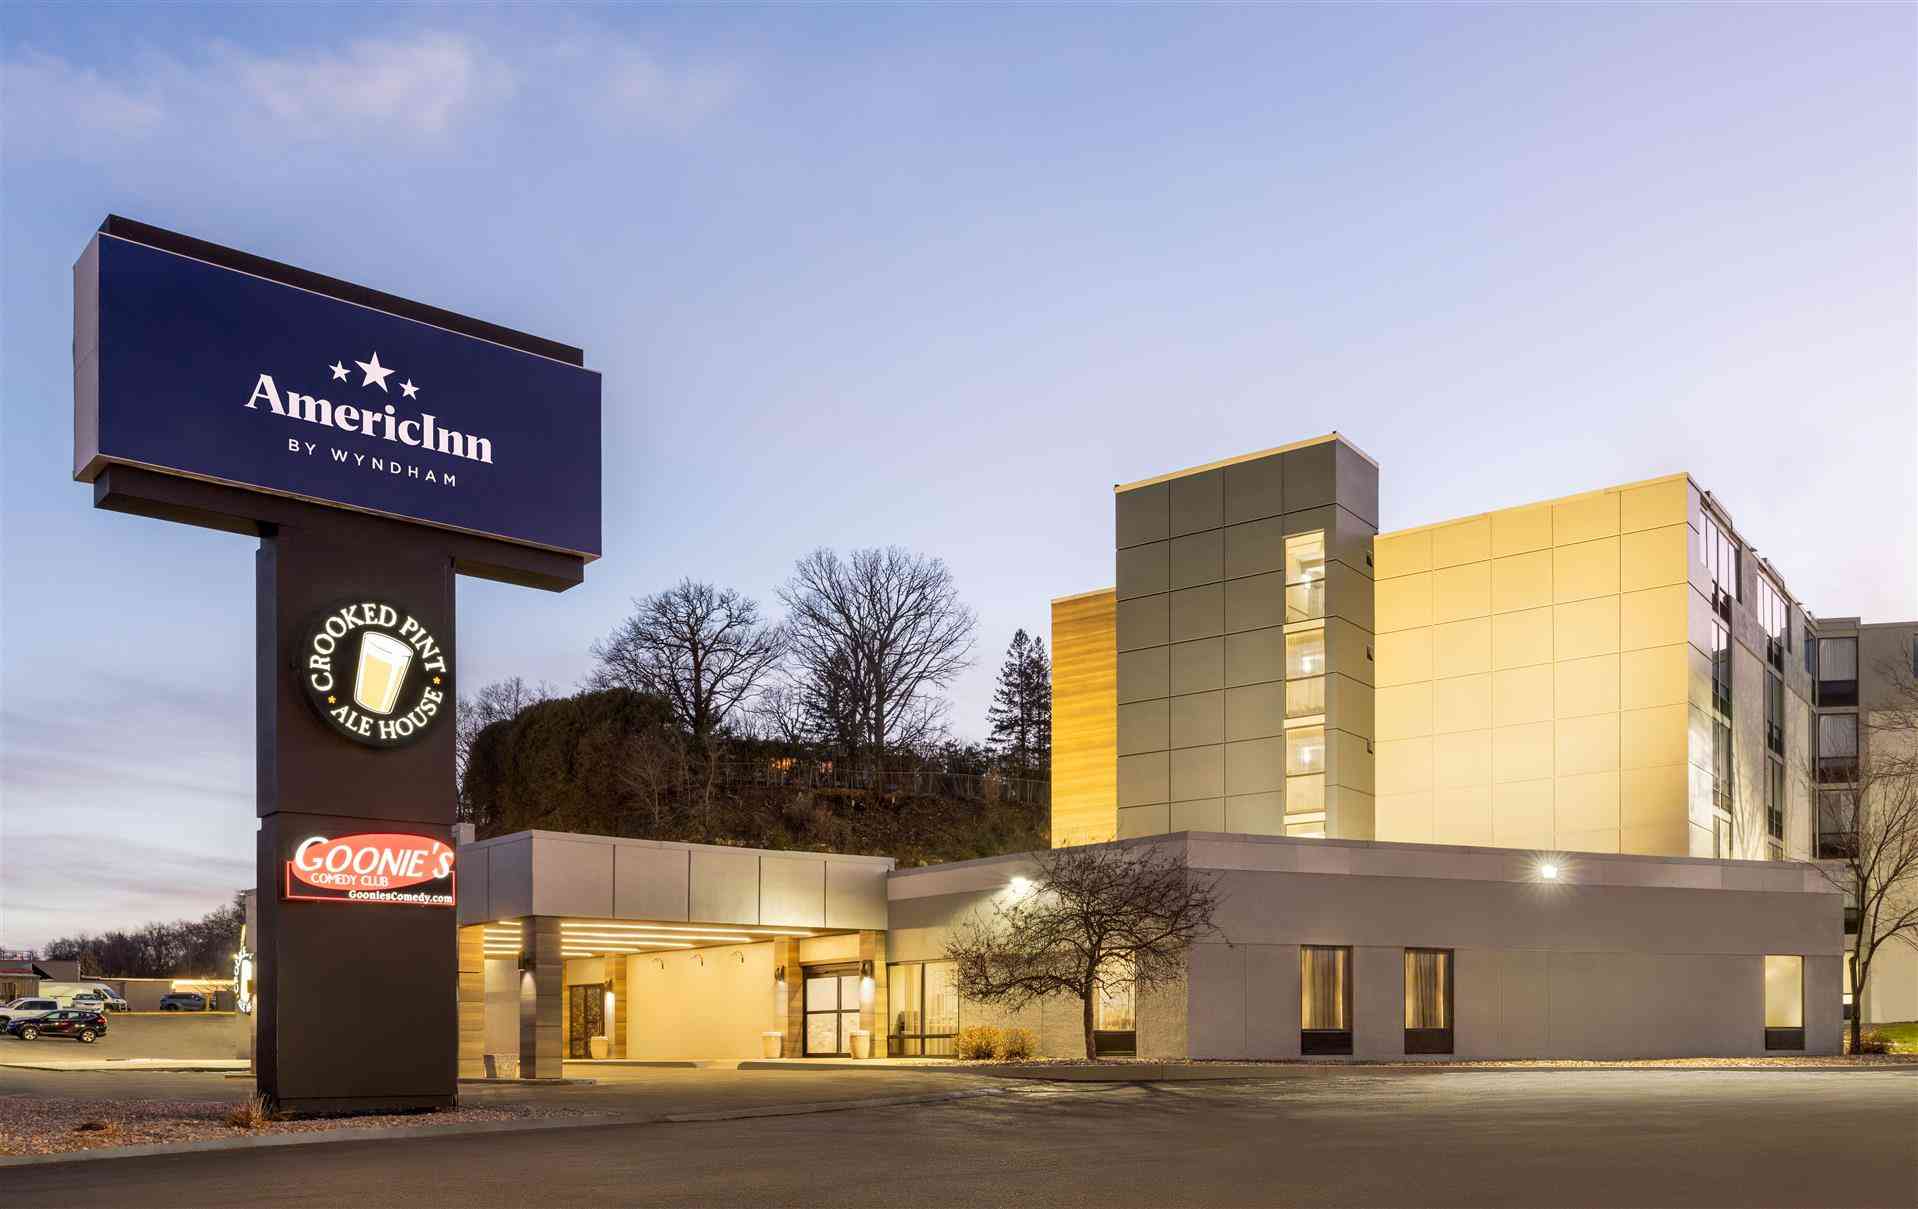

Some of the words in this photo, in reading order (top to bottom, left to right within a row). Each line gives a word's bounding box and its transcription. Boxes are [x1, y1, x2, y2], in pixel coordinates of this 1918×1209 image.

[244, 373, 493, 464] AmericInn
[288, 438, 316, 455] BY
[331, 448, 456, 486] WYNDHAM
[309, 603, 397, 692] CROOKED
[399, 616, 446, 673] PINT
[330, 705, 373, 736] ALE
[378, 687, 443, 739] HOUSE
[295, 836, 455, 879] GOONIE'S
[310, 872, 357, 885] COMEDY
[360, 875, 389, 887] CLUB
[348, 890, 453, 904] GooniesComedy.com
